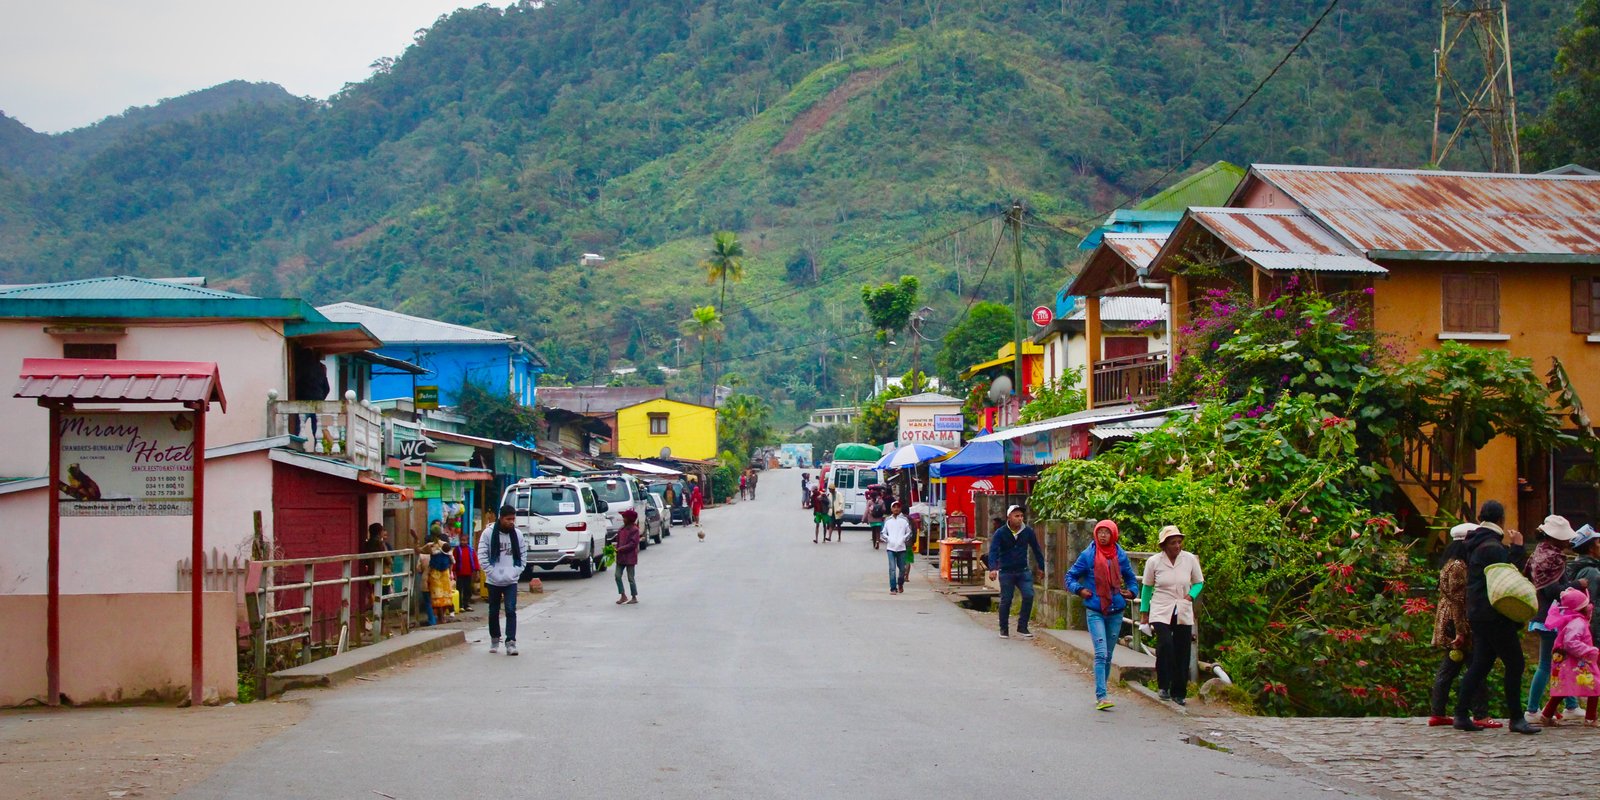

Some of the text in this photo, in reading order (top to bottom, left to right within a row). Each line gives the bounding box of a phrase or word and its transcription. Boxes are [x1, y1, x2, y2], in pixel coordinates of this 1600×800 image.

[60, 416, 141, 453] Mirary
[134, 440, 194, 463] Hotel
[400, 440, 426, 457] WC
[116, 503, 136, 512] partir
[137, 503, 146, 511] de
